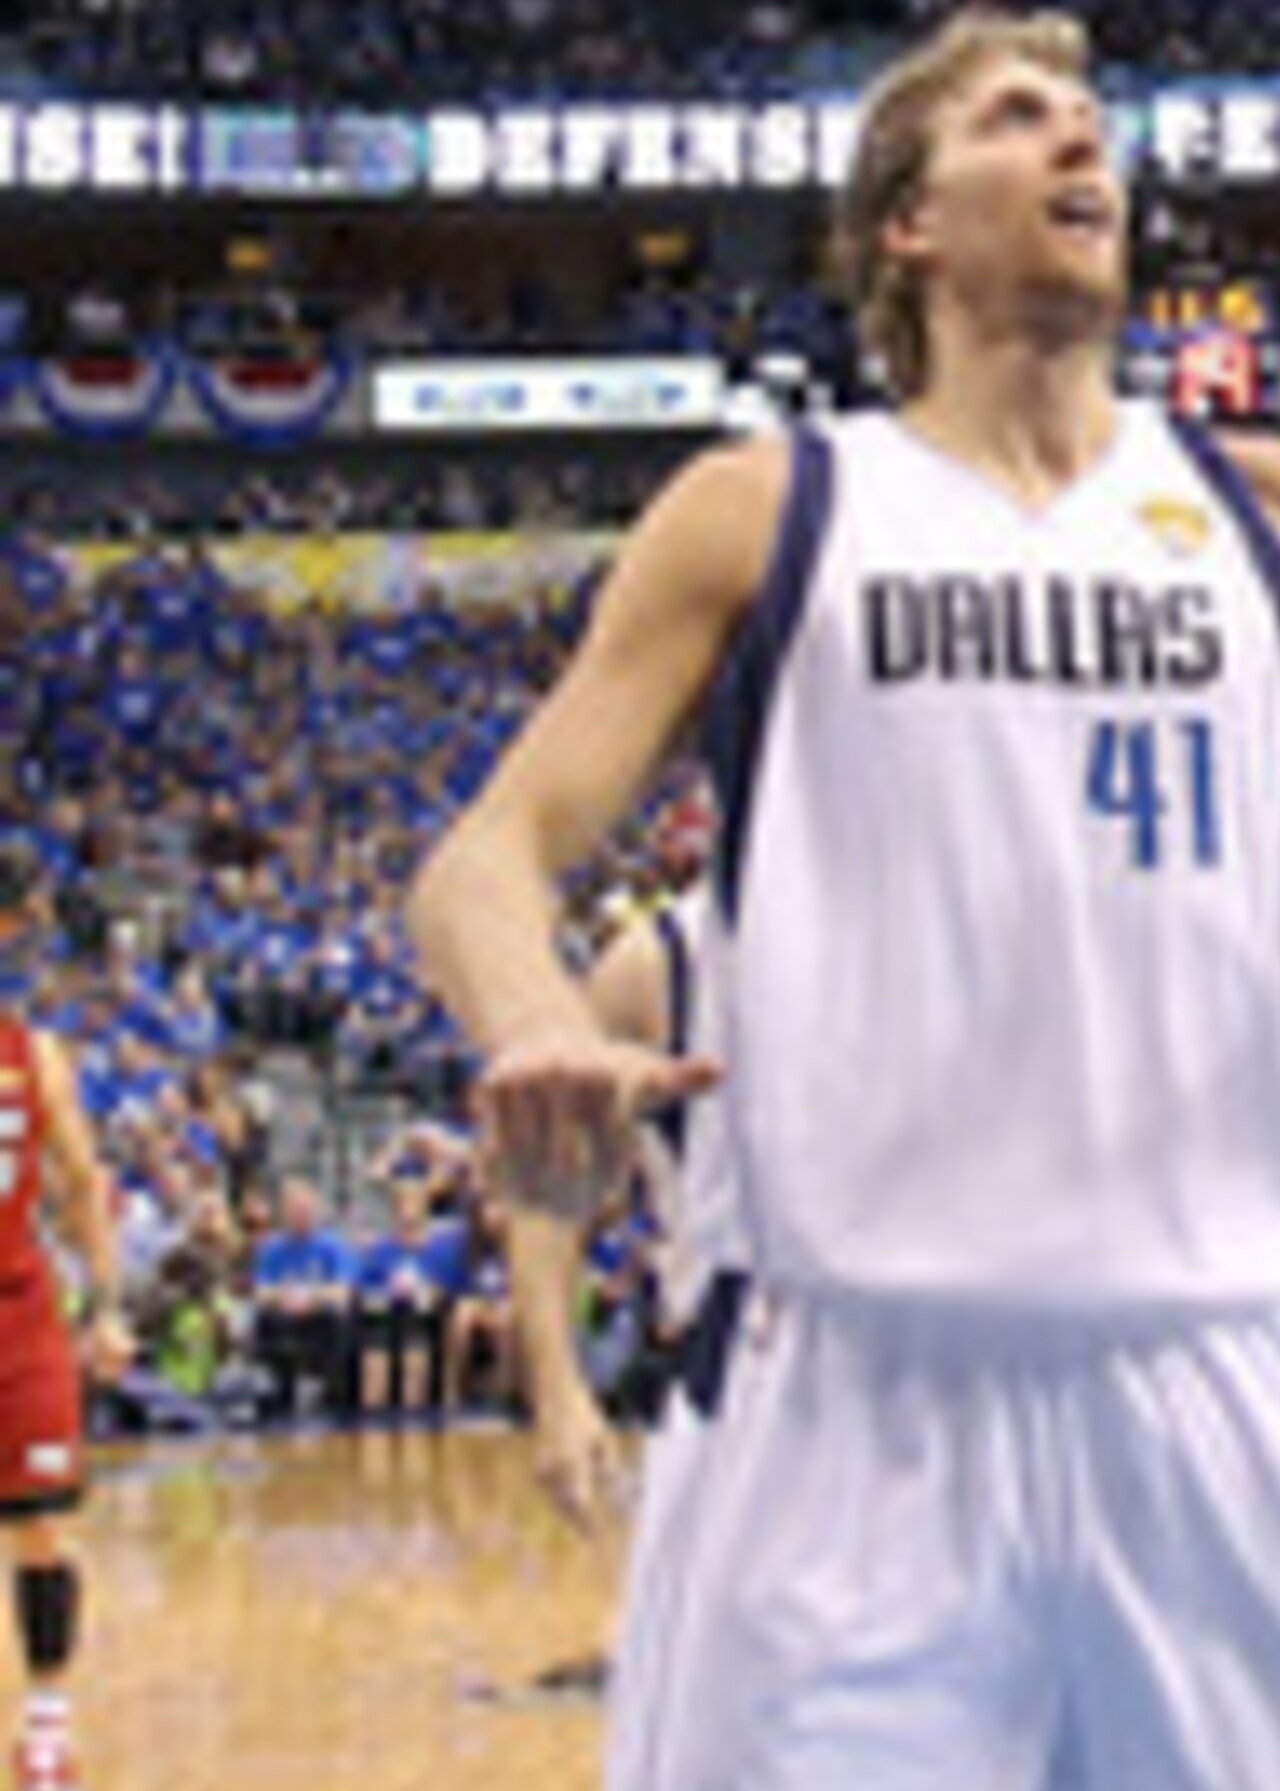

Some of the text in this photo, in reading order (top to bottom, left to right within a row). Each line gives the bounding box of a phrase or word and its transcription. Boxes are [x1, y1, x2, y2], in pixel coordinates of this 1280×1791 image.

[0, 102, 183, 192] SE!
[863, 573, 1223, 691] DALLAS
[1085, 717, 1221, 871] 41
